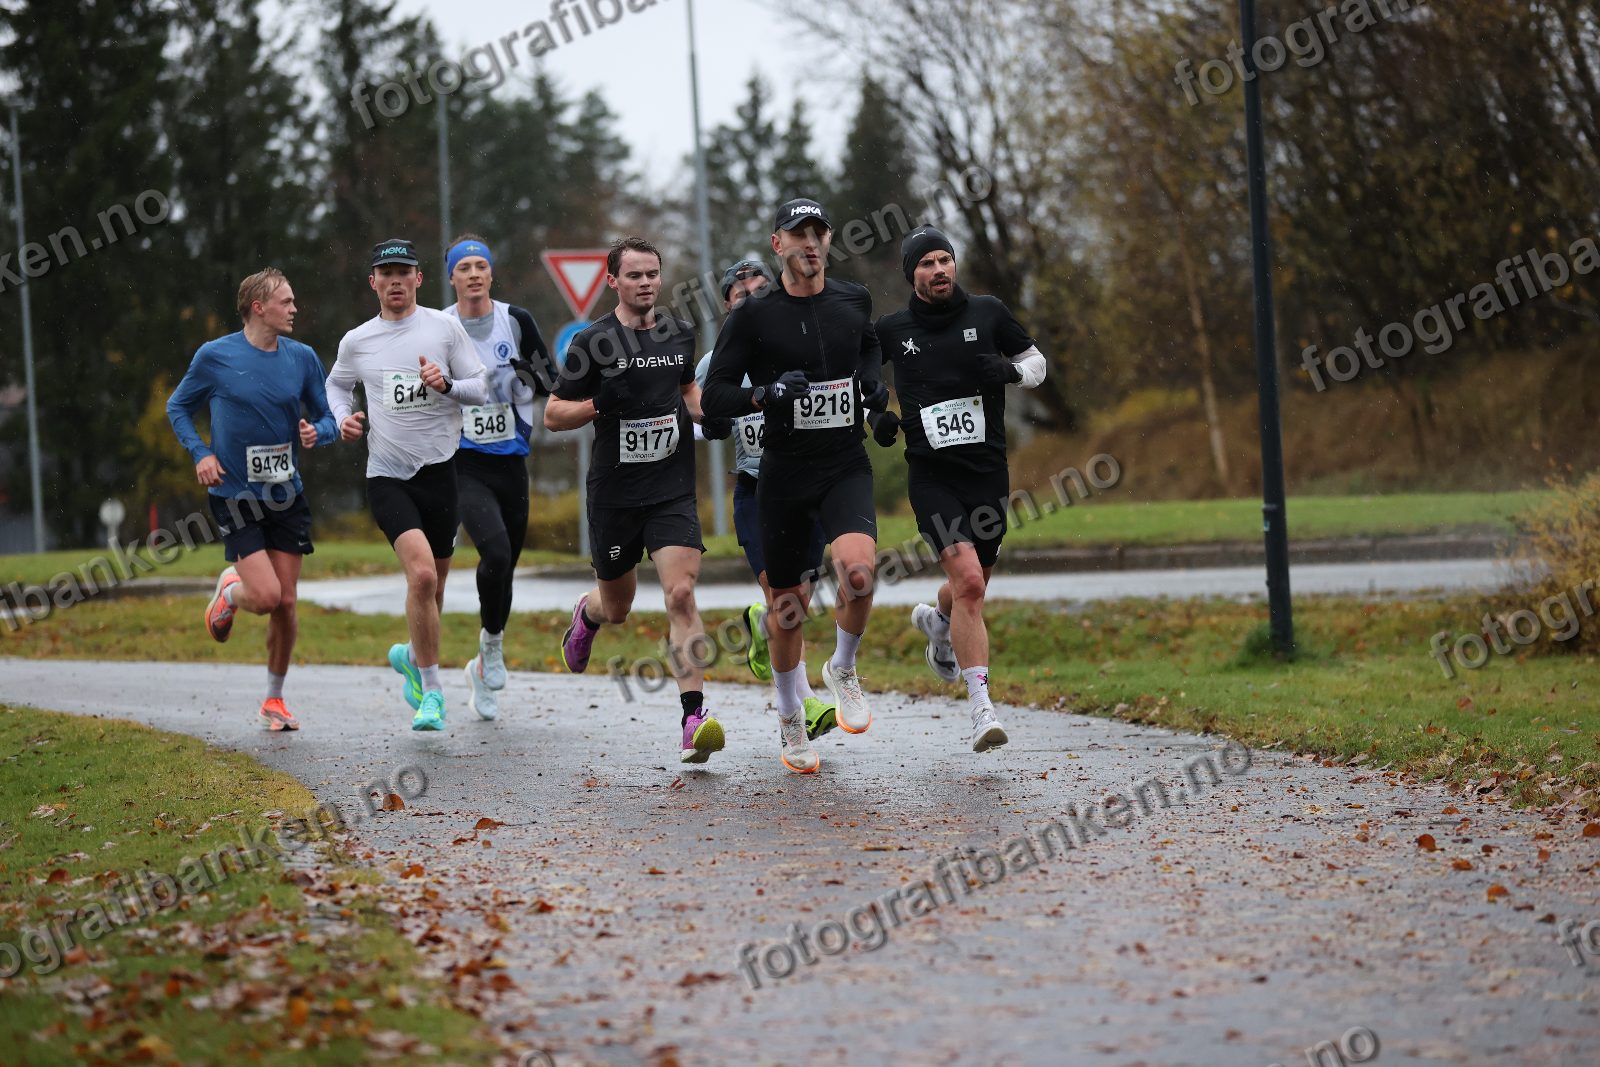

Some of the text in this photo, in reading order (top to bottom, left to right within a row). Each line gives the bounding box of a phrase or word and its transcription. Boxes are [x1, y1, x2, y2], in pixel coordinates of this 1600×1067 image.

[791, 205, 822, 217] HOKA
[381, 246, 407, 257] HOKA
[394, 383, 428, 404] 614
[800, 391, 850, 417] 9218
[474, 414, 506, 436] 548
[937, 411, 975, 437] 546
[626, 427, 675, 452] 9177
[252, 453, 289, 474] 9478
